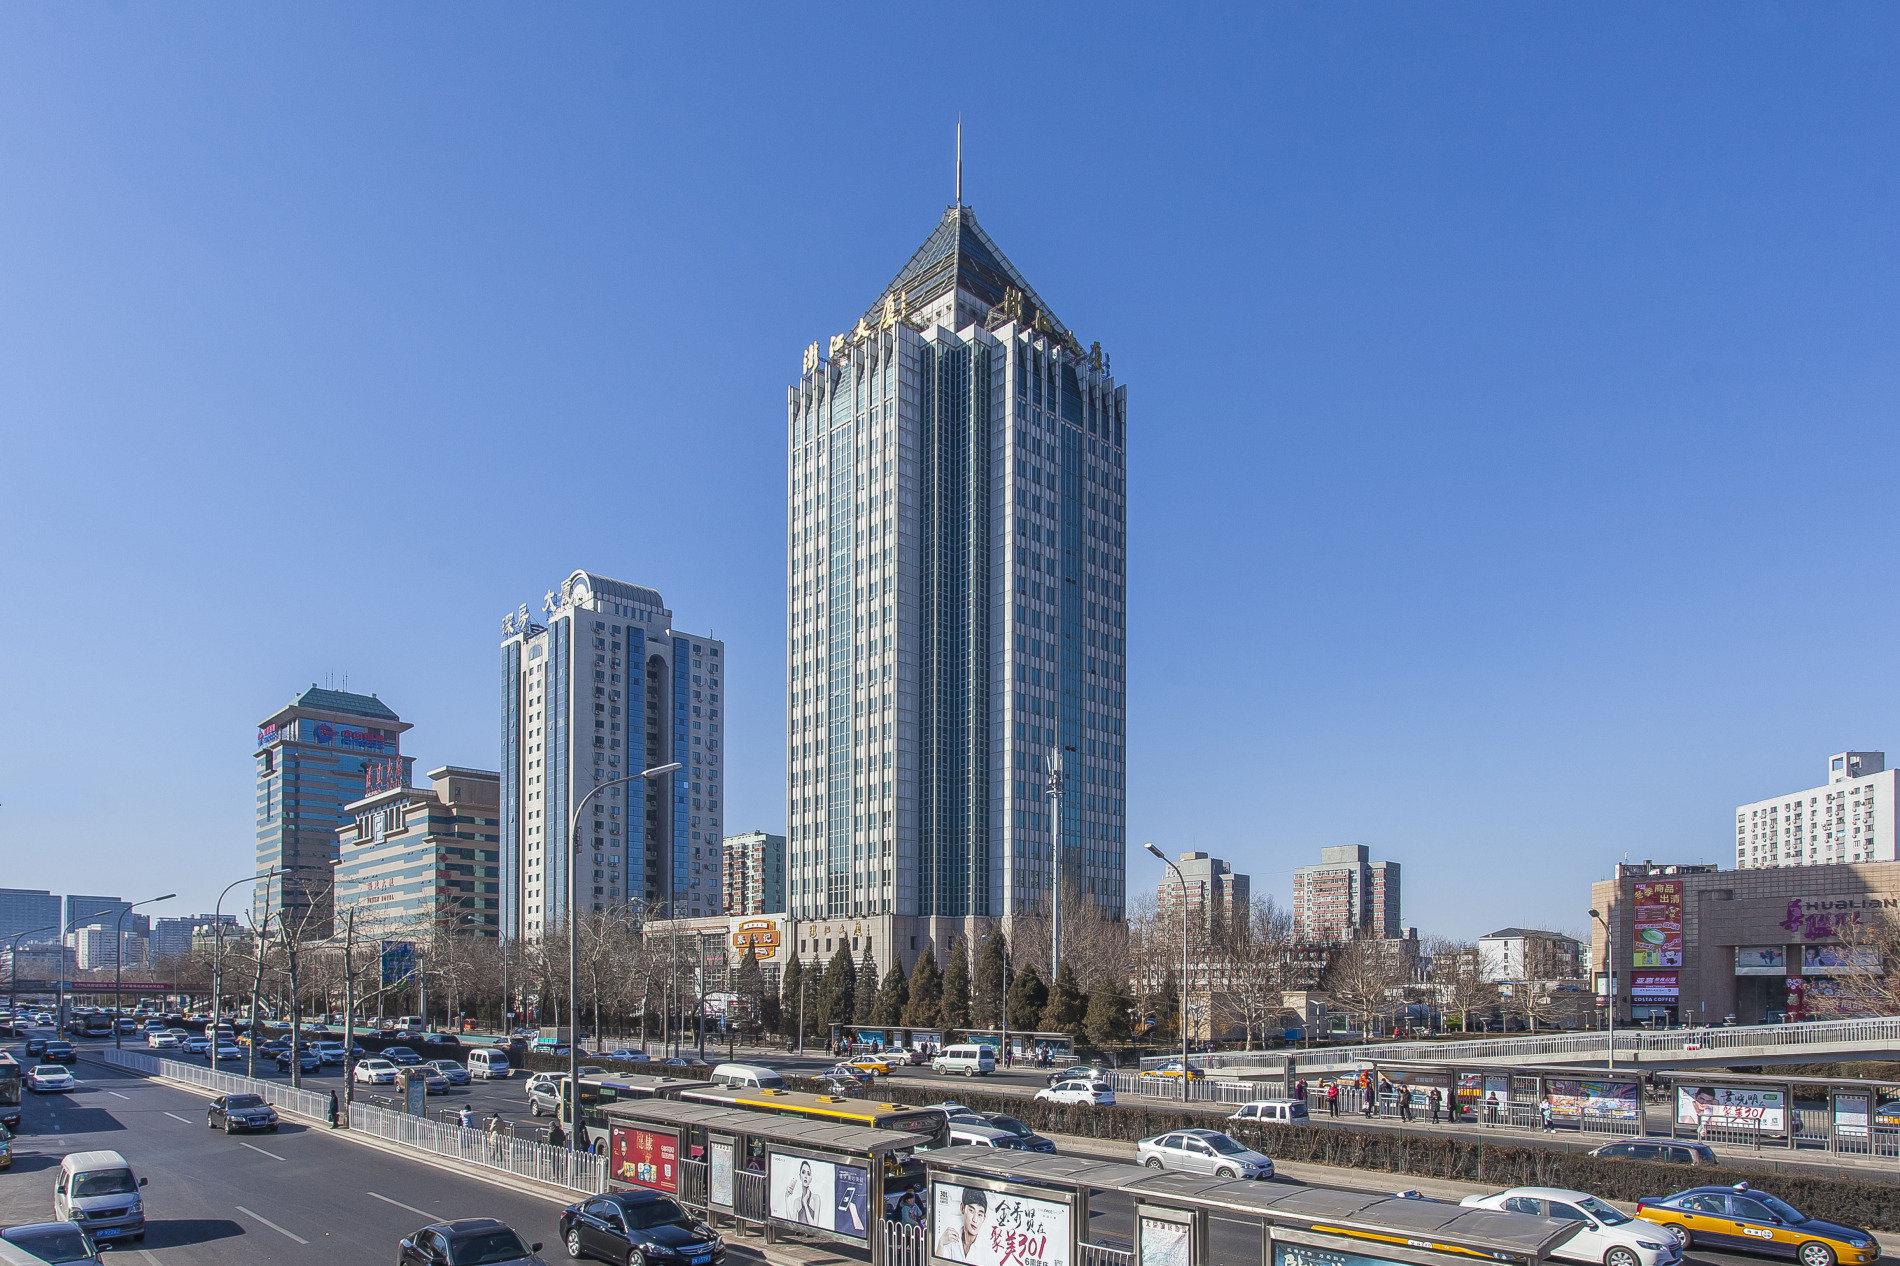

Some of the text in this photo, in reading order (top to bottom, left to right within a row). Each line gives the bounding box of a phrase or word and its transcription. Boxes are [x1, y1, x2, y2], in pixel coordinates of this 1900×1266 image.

[1634, 883, 1675, 900] 冬季商品
[1660, 893, 1680, 903] 出清
